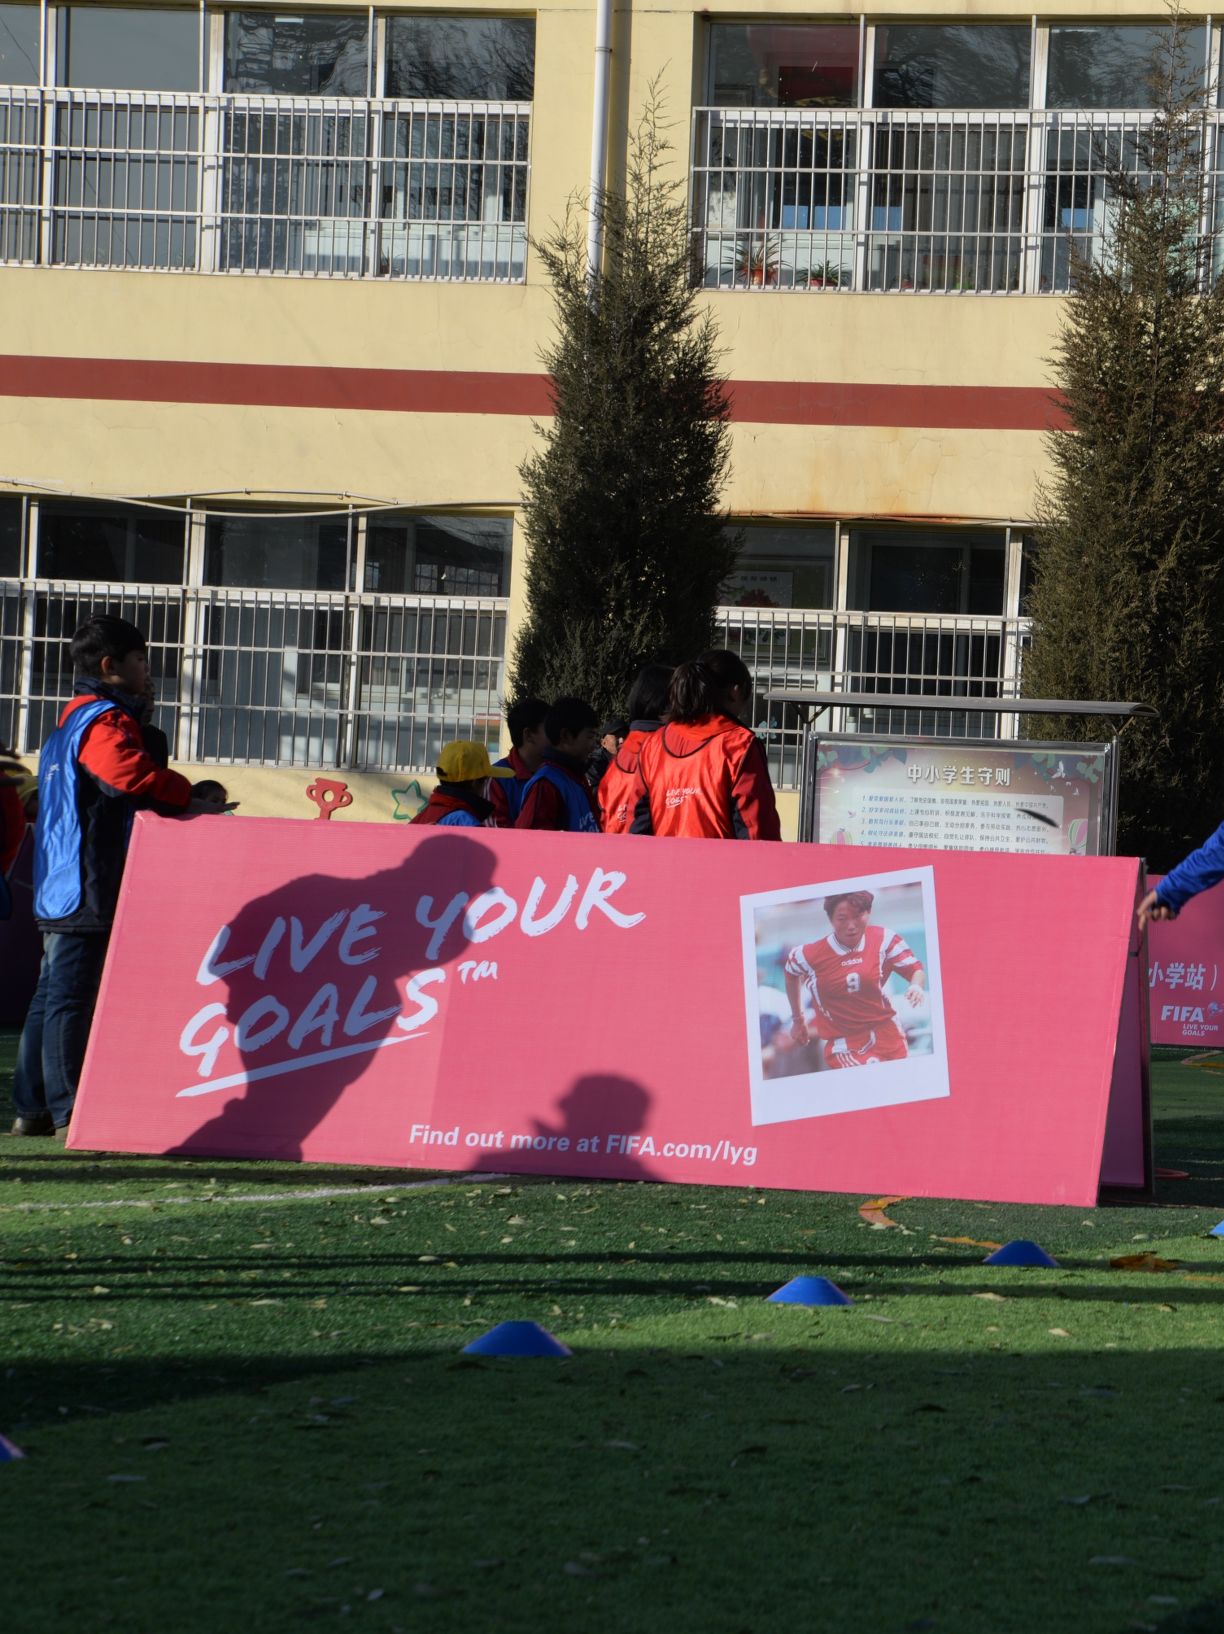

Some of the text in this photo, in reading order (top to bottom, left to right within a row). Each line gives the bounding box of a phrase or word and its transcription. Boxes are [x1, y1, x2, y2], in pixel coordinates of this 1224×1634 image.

[907, 764, 1011, 786] 中小学生守则
[195, 867, 647, 986] LIVE YOUR
[846, 972, 860, 993] 9
[179, 967, 446, 1077] GOALS
[1161, 1005, 1204, 1023] FIFA
[1182, 1029, 1206, 1037] GOALS
[1183, 1023, 1219, 1032] LIVE YOUR
[409, 1124, 758, 1167] Find out more at FIFA.com/lyg
